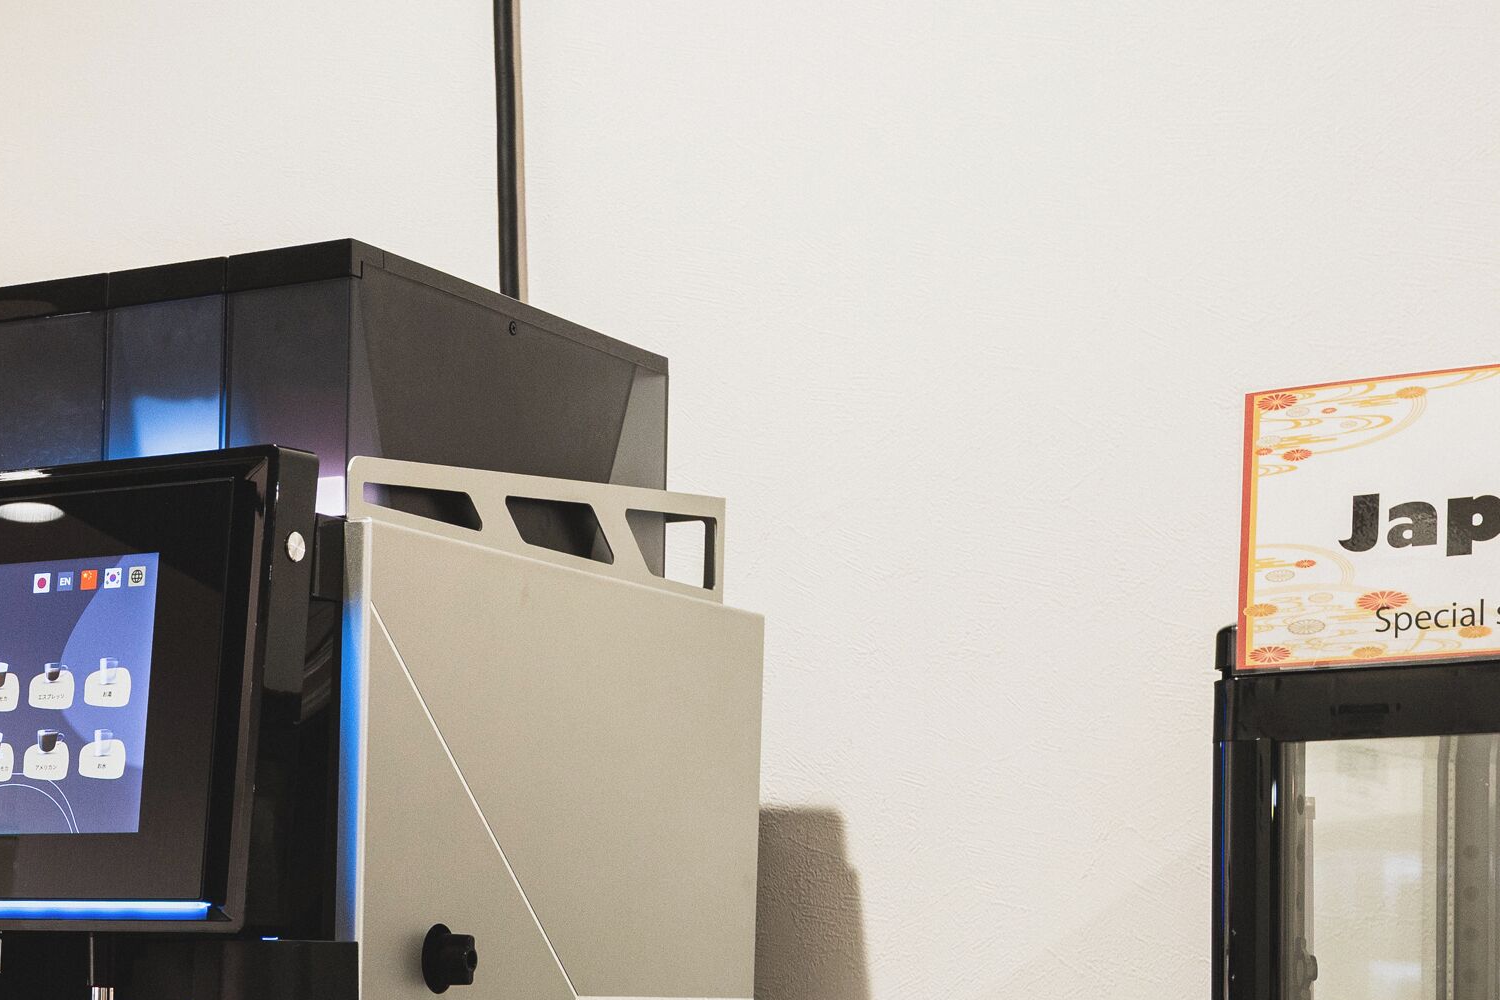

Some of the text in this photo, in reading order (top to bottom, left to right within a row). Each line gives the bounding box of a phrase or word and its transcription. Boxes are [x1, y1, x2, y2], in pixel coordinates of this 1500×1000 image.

[1338, 493, 1500, 557] Jap
[59, 577, 71, 586] EN
[1375, 598, 1485, 639] Special
